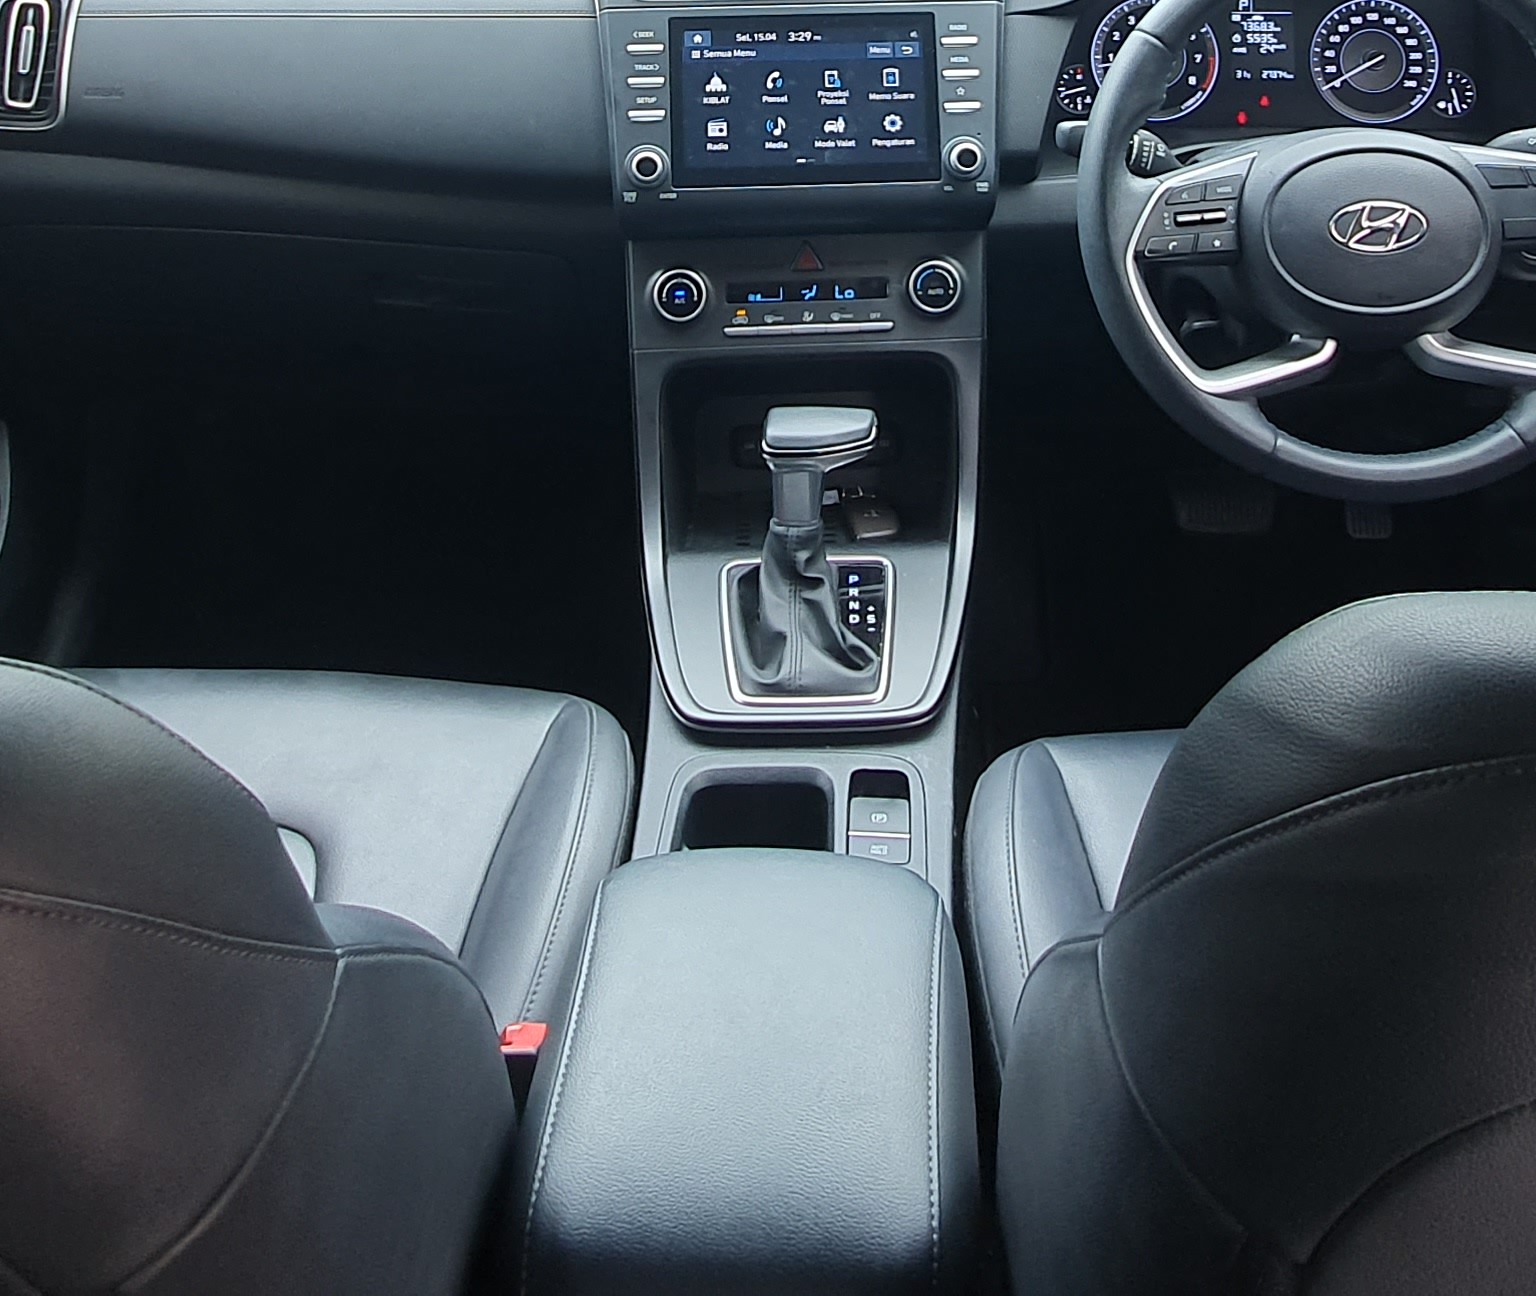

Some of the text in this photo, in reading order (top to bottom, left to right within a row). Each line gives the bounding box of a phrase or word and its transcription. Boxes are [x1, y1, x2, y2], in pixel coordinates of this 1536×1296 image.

[1127, 16, 1136, 25] 3
[788, 31, 812, 42] 3:29
[1112, 31, 1121, 41] 2
[1329, 35, 1341, 43] 60
[703, 49, 757, 58] Semua Menu
[869, 46, 891, 54] Menu
[1108, 53, 1114, 62] 1
[1194, 54, 1202, 63] 7
[1324, 65, 1337, 73] 20
[1188, 75, 1196, 85] 8
[636, 96, 658, 104] SETUP
[762, 94, 788, 103] Ponsel
[894, 92, 915, 100] Suara
[706, 142, 729, 151] Radio
[765, 141, 789, 149] Media
[815, 139, 856, 148] Mode Valet
[848, 574, 860, 584] P
[849, 588, 860, 597] R
[848, 601, 860, 610] N
[849, 614, 860, 624] D
[867, 614, 876, 624] S
